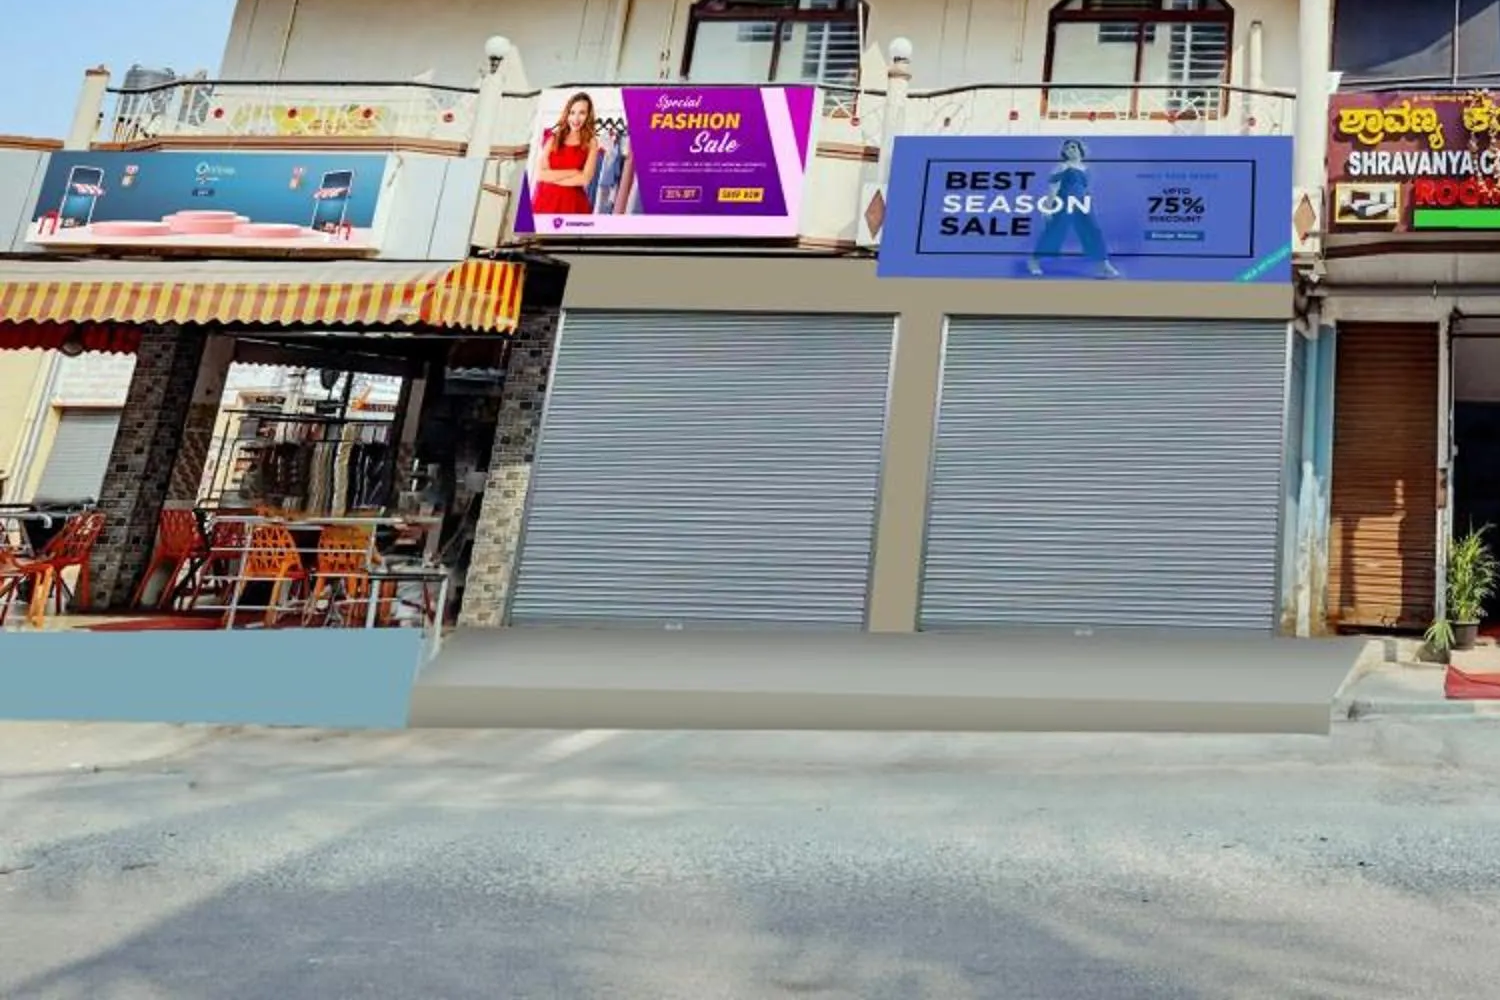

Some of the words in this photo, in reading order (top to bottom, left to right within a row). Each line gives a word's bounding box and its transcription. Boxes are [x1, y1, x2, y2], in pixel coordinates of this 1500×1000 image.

[656, 94, 703, 112] Special
[650, 112, 741, 130] FASHION
[689, 130, 740, 154] Sale
[1348, 149, 1477, 176] SHRAVANYA
[945, 171, 1036, 191] BEST
[943, 194, 1092, 214] SEASON
[1147, 196, 1206, 214] 75%
[939, 216, 1033, 236] SALE
